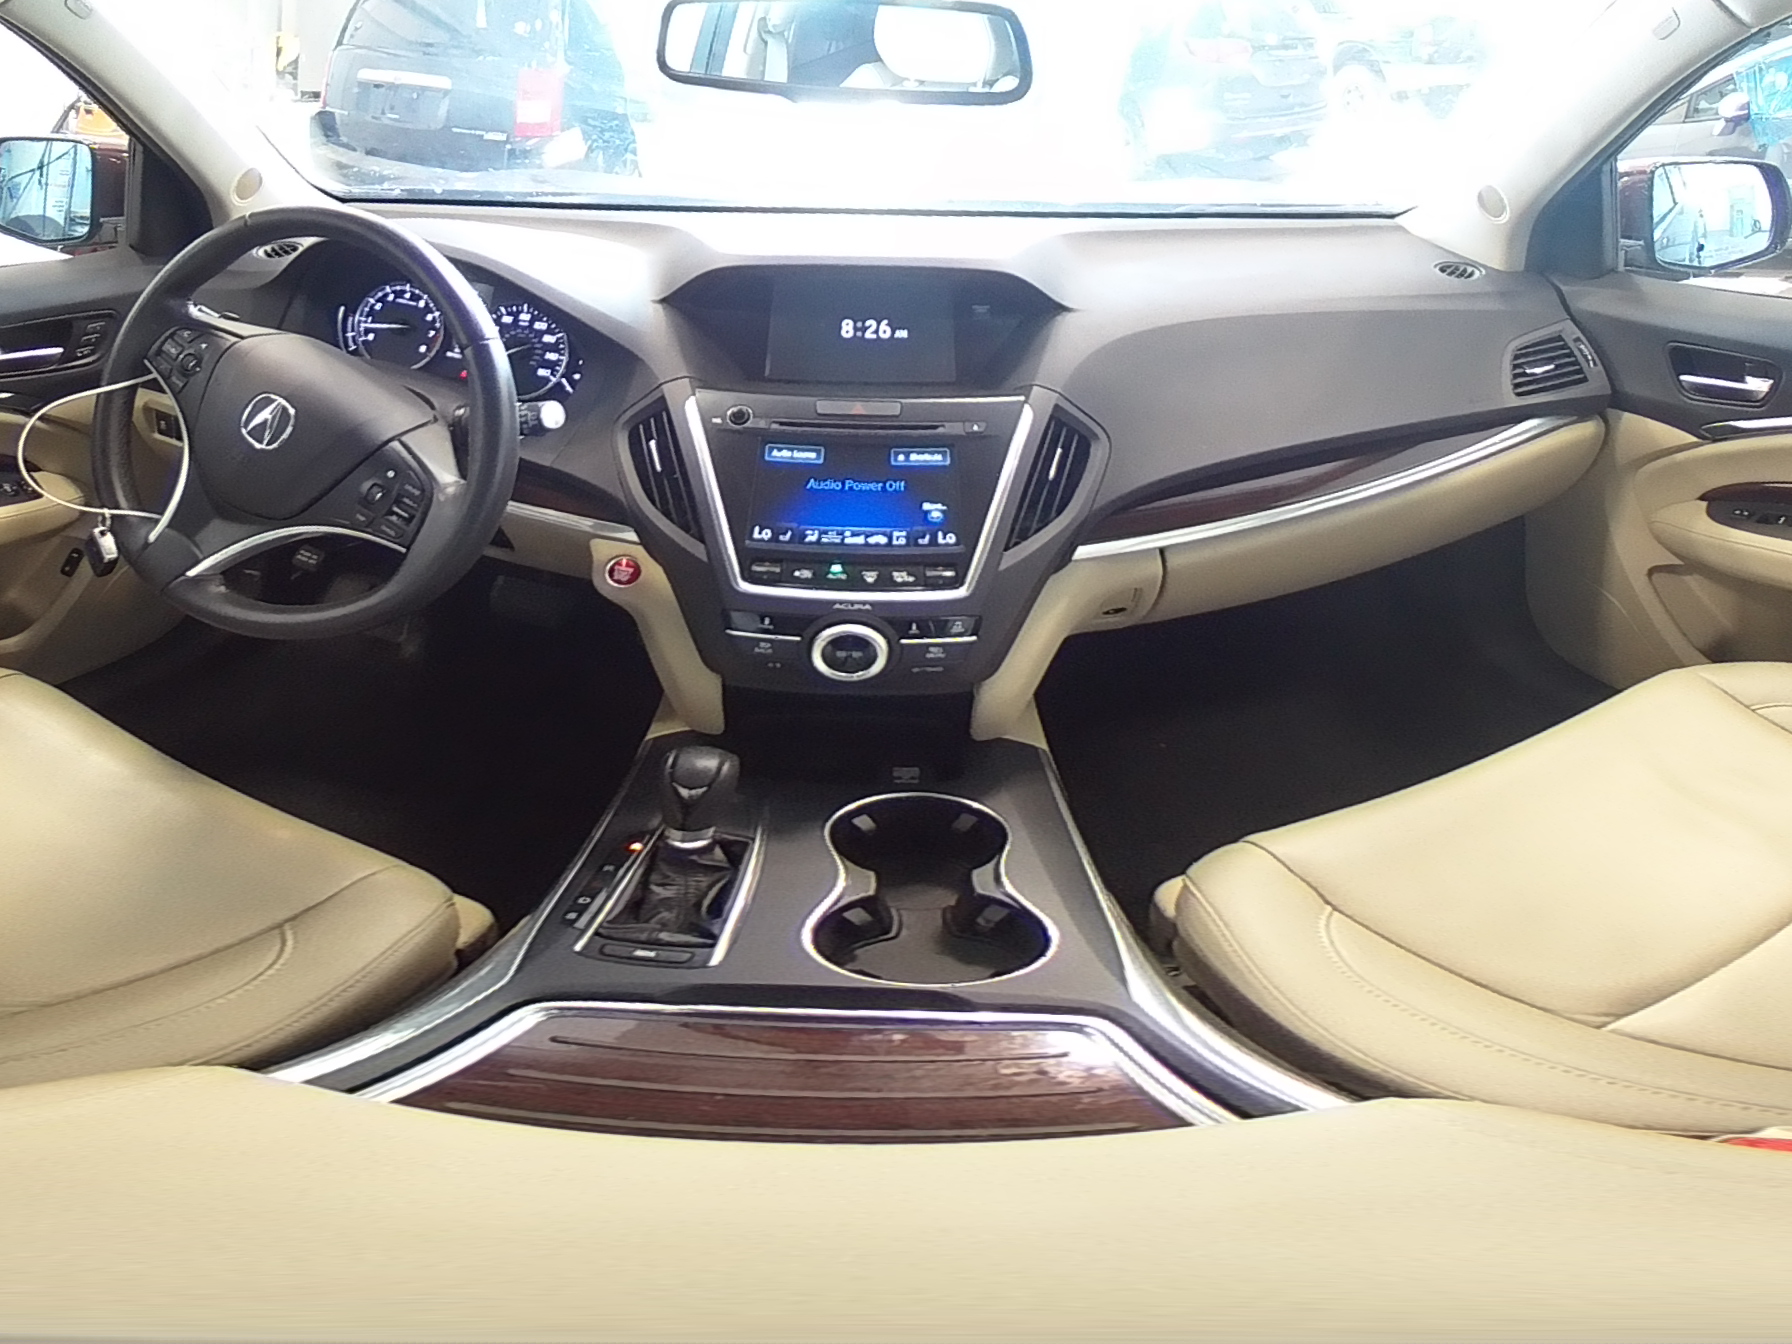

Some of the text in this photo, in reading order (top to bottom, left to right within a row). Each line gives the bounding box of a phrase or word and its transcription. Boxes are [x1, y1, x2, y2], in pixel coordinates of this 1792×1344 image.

[840, 318, 892, 339] 8:26
[806, 478, 906, 492] Audio Power Off
[832, 602, 873, 611] ACURA
